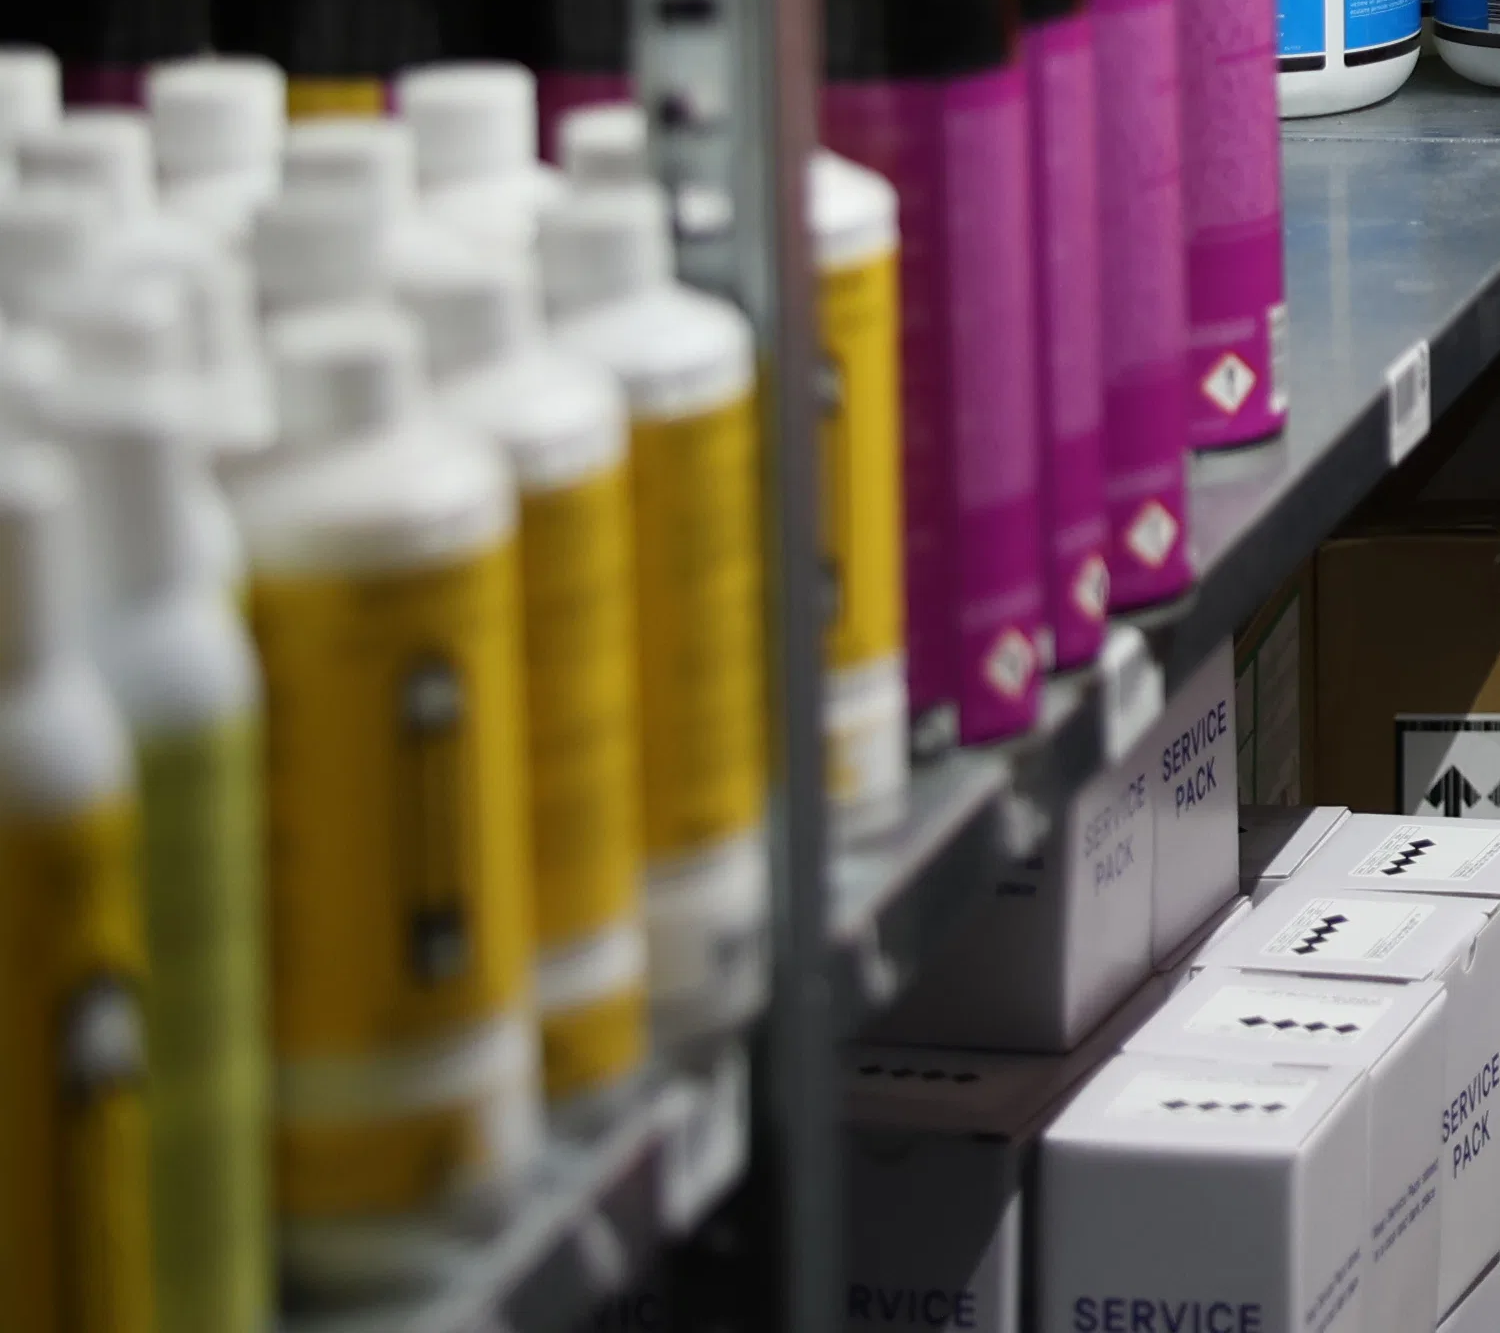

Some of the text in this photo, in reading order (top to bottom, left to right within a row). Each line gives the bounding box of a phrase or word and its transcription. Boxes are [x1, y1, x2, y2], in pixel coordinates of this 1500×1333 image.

[1163, 699, 1228, 783] SERVICE
[1175, 756, 1218, 820] PACK
[1441, 1051, 1500, 1145] SERVICE
[1452, 1109, 1492, 1179] PACK
[1074, 1296, 1262, 1333] SERVICE
